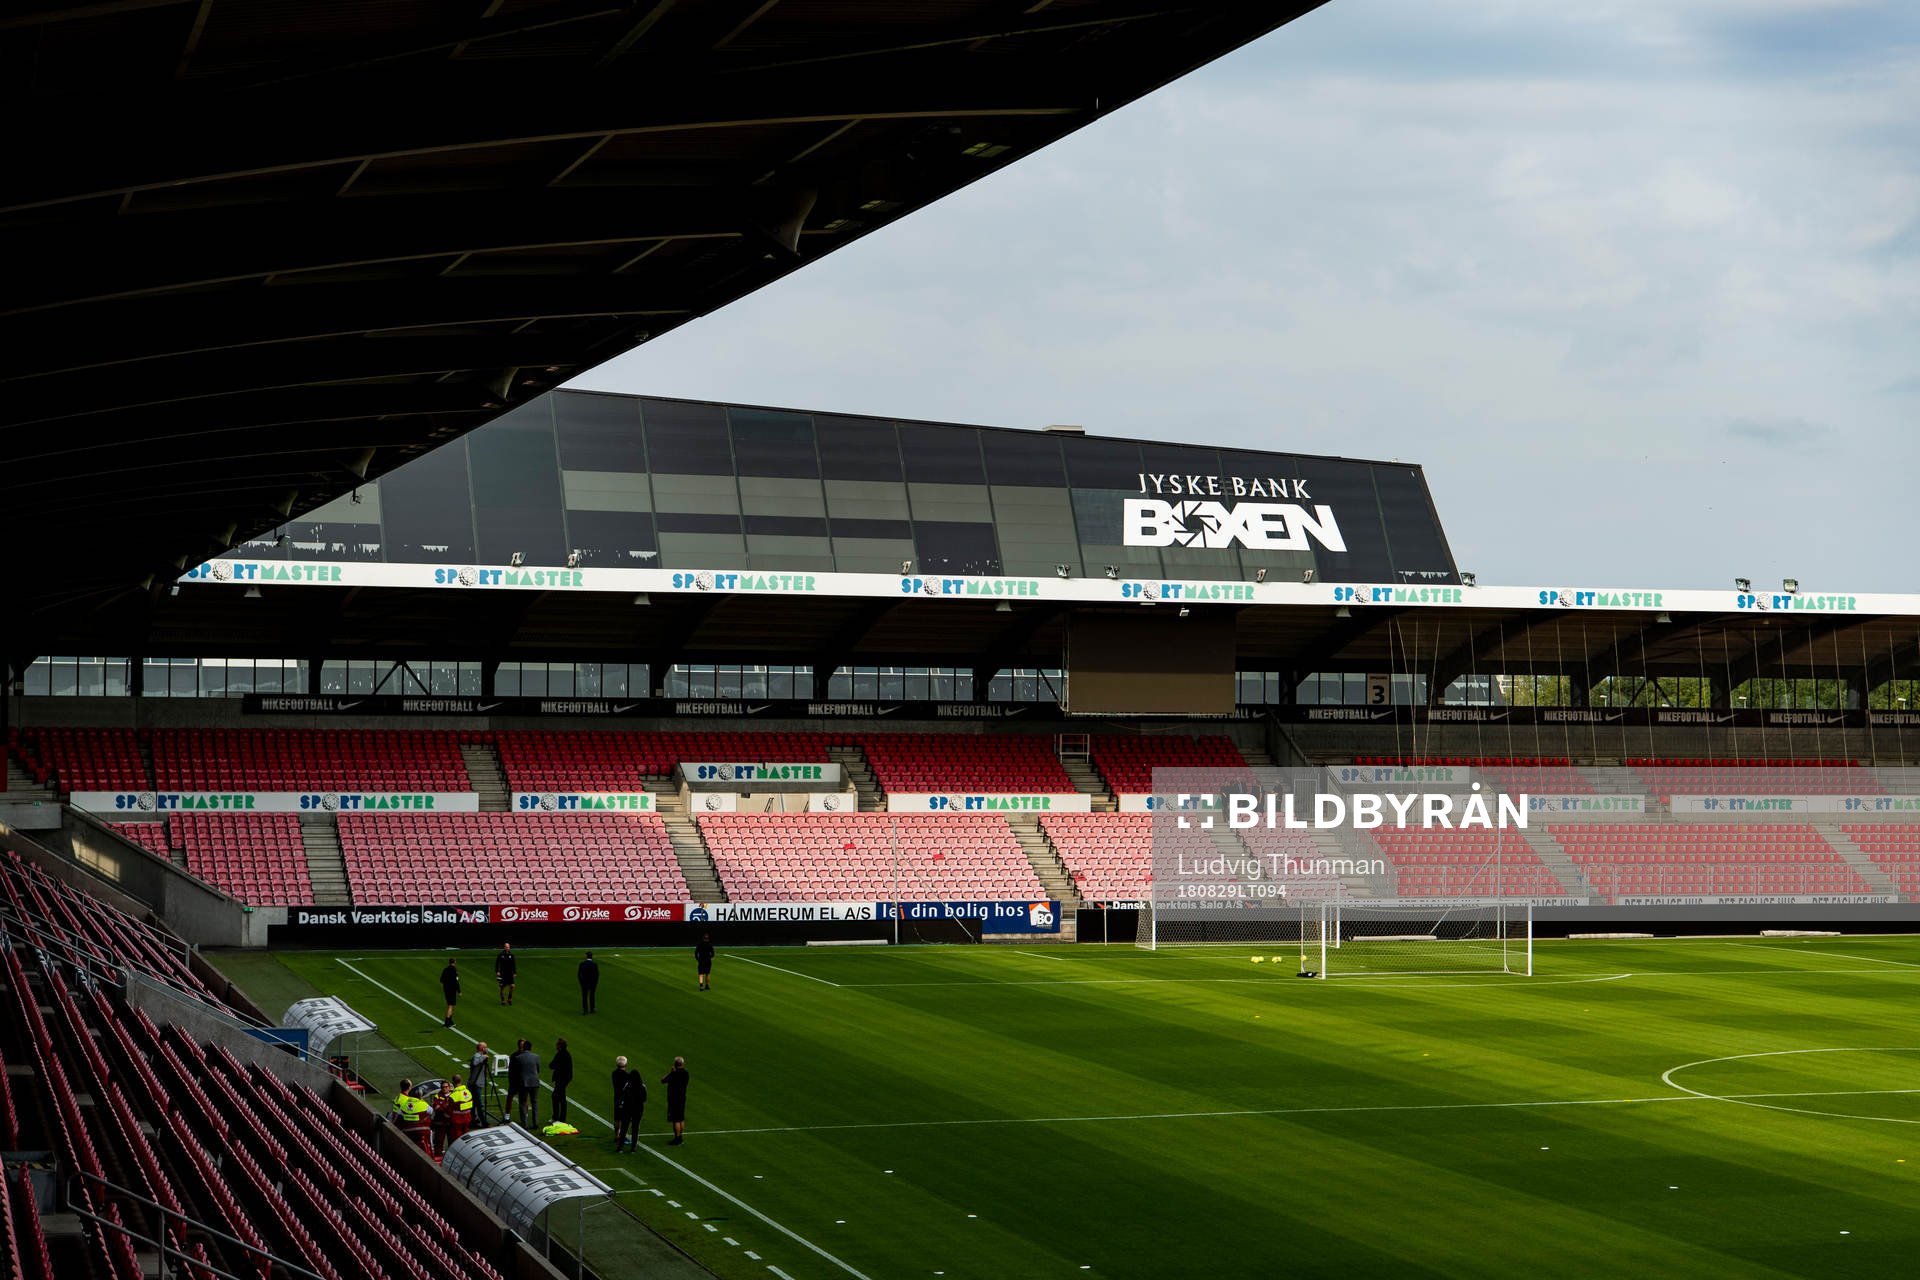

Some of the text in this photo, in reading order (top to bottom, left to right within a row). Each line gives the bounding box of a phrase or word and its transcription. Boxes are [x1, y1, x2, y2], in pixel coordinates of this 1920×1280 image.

[1138, 473, 1312, 499] JYSKE BANK
[1124, 499, 1348, 552] BOXEN
[434, 567, 584, 587] SPORTMASTER
[672, 571, 815, 591] SPORTMASTER
[901, 577, 1039, 596] SPORTMASTER
[1121, 581, 1254, 601] SPORTMASTER
[1334, 585, 1463, 604] SPORTMASTER
[1539, 589, 1663, 608] SPORTMASTER
[1737, 593, 1856, 611] SPORTMASTER
[1372, 685, 1385, 703] 3
[262, 698, 334, 711] NIKEFOOTBALL
[403, 700, 473, 712] NIKEFOOTBALL
[540, 701, 610, 714] NIKEFOOTBALL
[675, 702, 743, 715] NIKEFOOTBALL
[808, 703, 874, 716] NIKEFOOTBALL
[937, 705, 1001, 717] NIKEFOOTBALL
[1309, 709, 1370, 720] NIKEFOOTBALL
[1428, 710, 1487, 721] NIKEFOOTBALL
[1544, 711, 1602, 722] NIKEFOOTBALL
[1658, 712, 1715, 723] NIKEFOOTBALL
[1770, 713, 1825, 724] NIKEFOOTBALL
[697, 763, 822, 781] SPORTMASTER
[115, 792, 255, 811] SPORTMASTER
[300, 792, 435, 811] SPORTMASTER
[519, 793, 650, 811] SPORTMASTER
[929, 794, 1051, 812] SPORTMASTER
[911, 903, 938, 917] din
[945, 903, 988, 920] bolig
[995, 903, 1024, 917] hos
[1112, 901, 1146, 910] Dansk
[298, 911, 347, 924] Dansk
[460, 910, 485, 923] A/S
[519, 908, 548, 921] jyske
[581, 908, 610, 920] jyske
[643, 908, 671, 920] jyske
[716, 907, 809, 920] HAMMERUM
[820, 907, 839, 920] EL
[844, 907, 871, 920] A/S
[1037, 912, 1054, 926] BO
